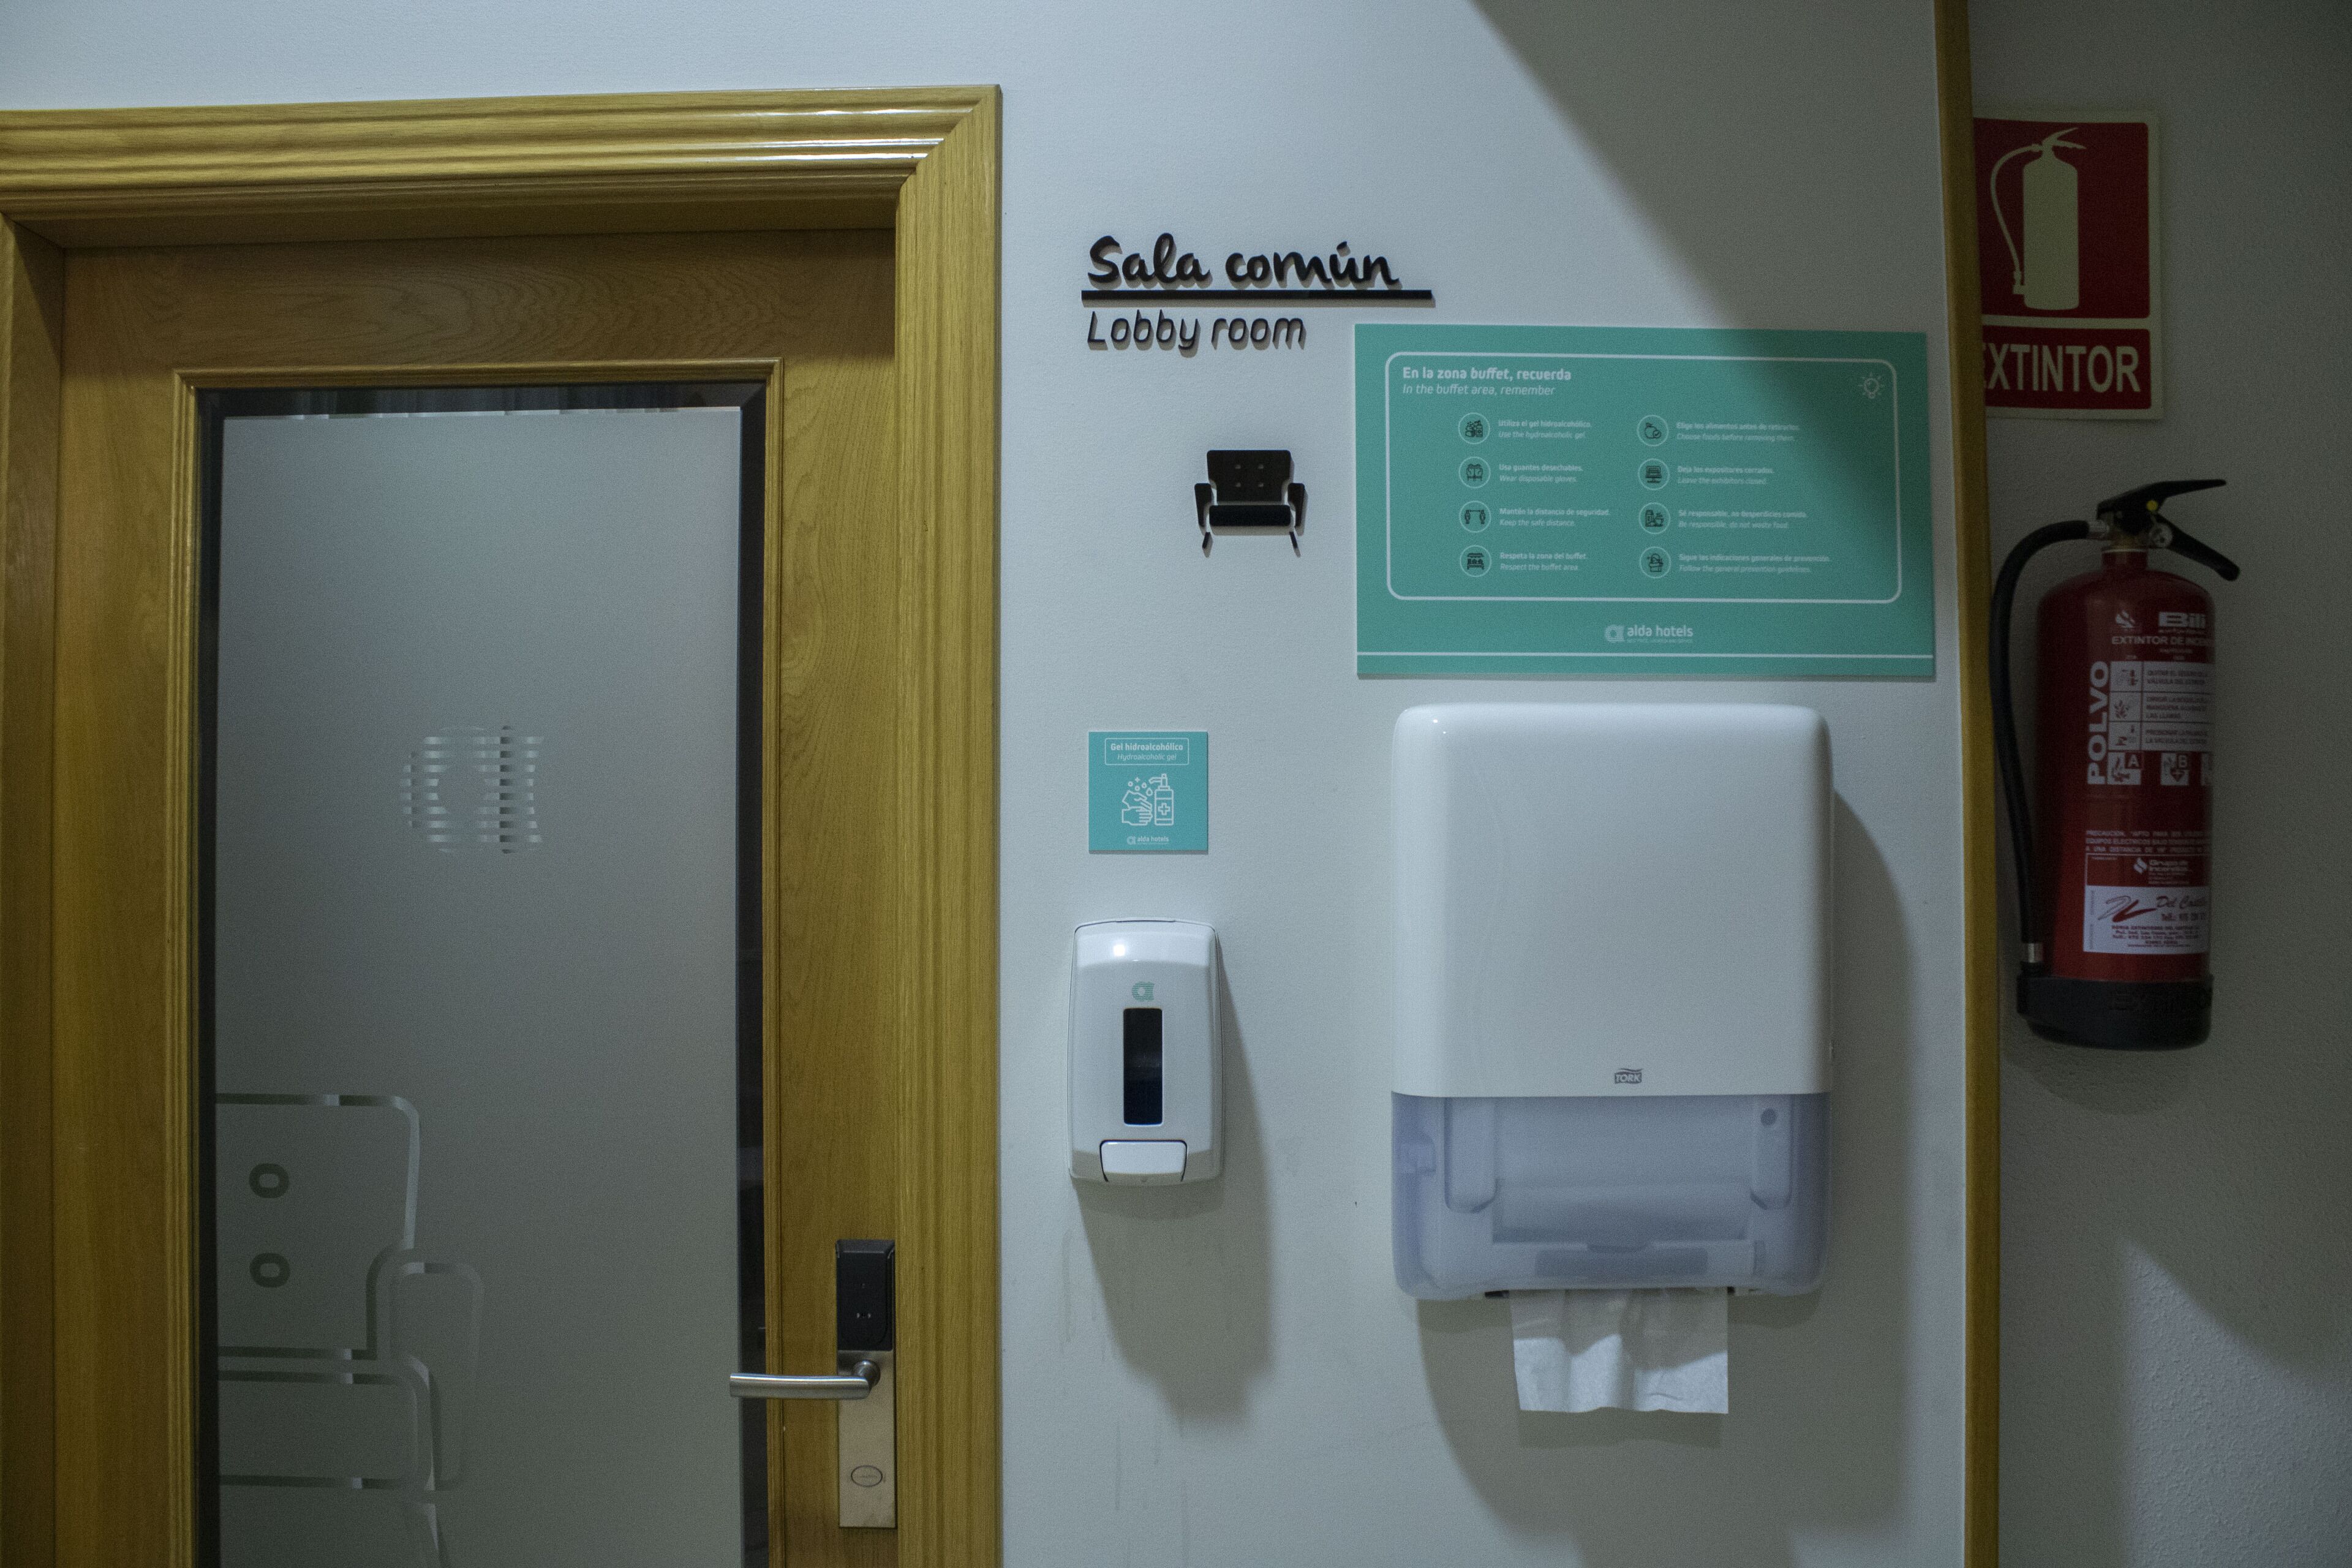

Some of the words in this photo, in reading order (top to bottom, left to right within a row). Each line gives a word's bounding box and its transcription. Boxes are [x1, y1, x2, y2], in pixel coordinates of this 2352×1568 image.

[1088, 233, 1212, 284] Sala
[1226, 241, 1400, 285] común
[1087, 309, 1199, 350] Lobby
[1211, 317, 1305, 344] room
[1983, 342, 2141, 393] XTINTOR
[1403, 367, 1419, 379] En
[1423, 367, 1433, 379] la
[1437, 369, 1467, 379] zona
[1471, 367, 1513, 382] buffet,
[1517, 368, 1572, 380] recuerda
[1403, 383, 1412, 394] In
[1416, 384, 1433, 394] the
[1436, 383, 1469, 394] buffet
[1471, 386, 1497, 396] area,
[1501, 385, 1556, 395] remember
[1627, 624, 1653, 637] alda
[1656, 624, 1694, 637] hotels
[2112, 635, 2168, 645] EXTINTOR
[2170, 636, 2184, 646] DE
[2087, 661, 2109, 785] POLVO
[1125, 742, 1183, 751] hidroalcohólico
[2128, 754, 2139, 767] A
[2179, 755, 2188, 767] B
[1615, 1073, 1642, 1083] TORK
